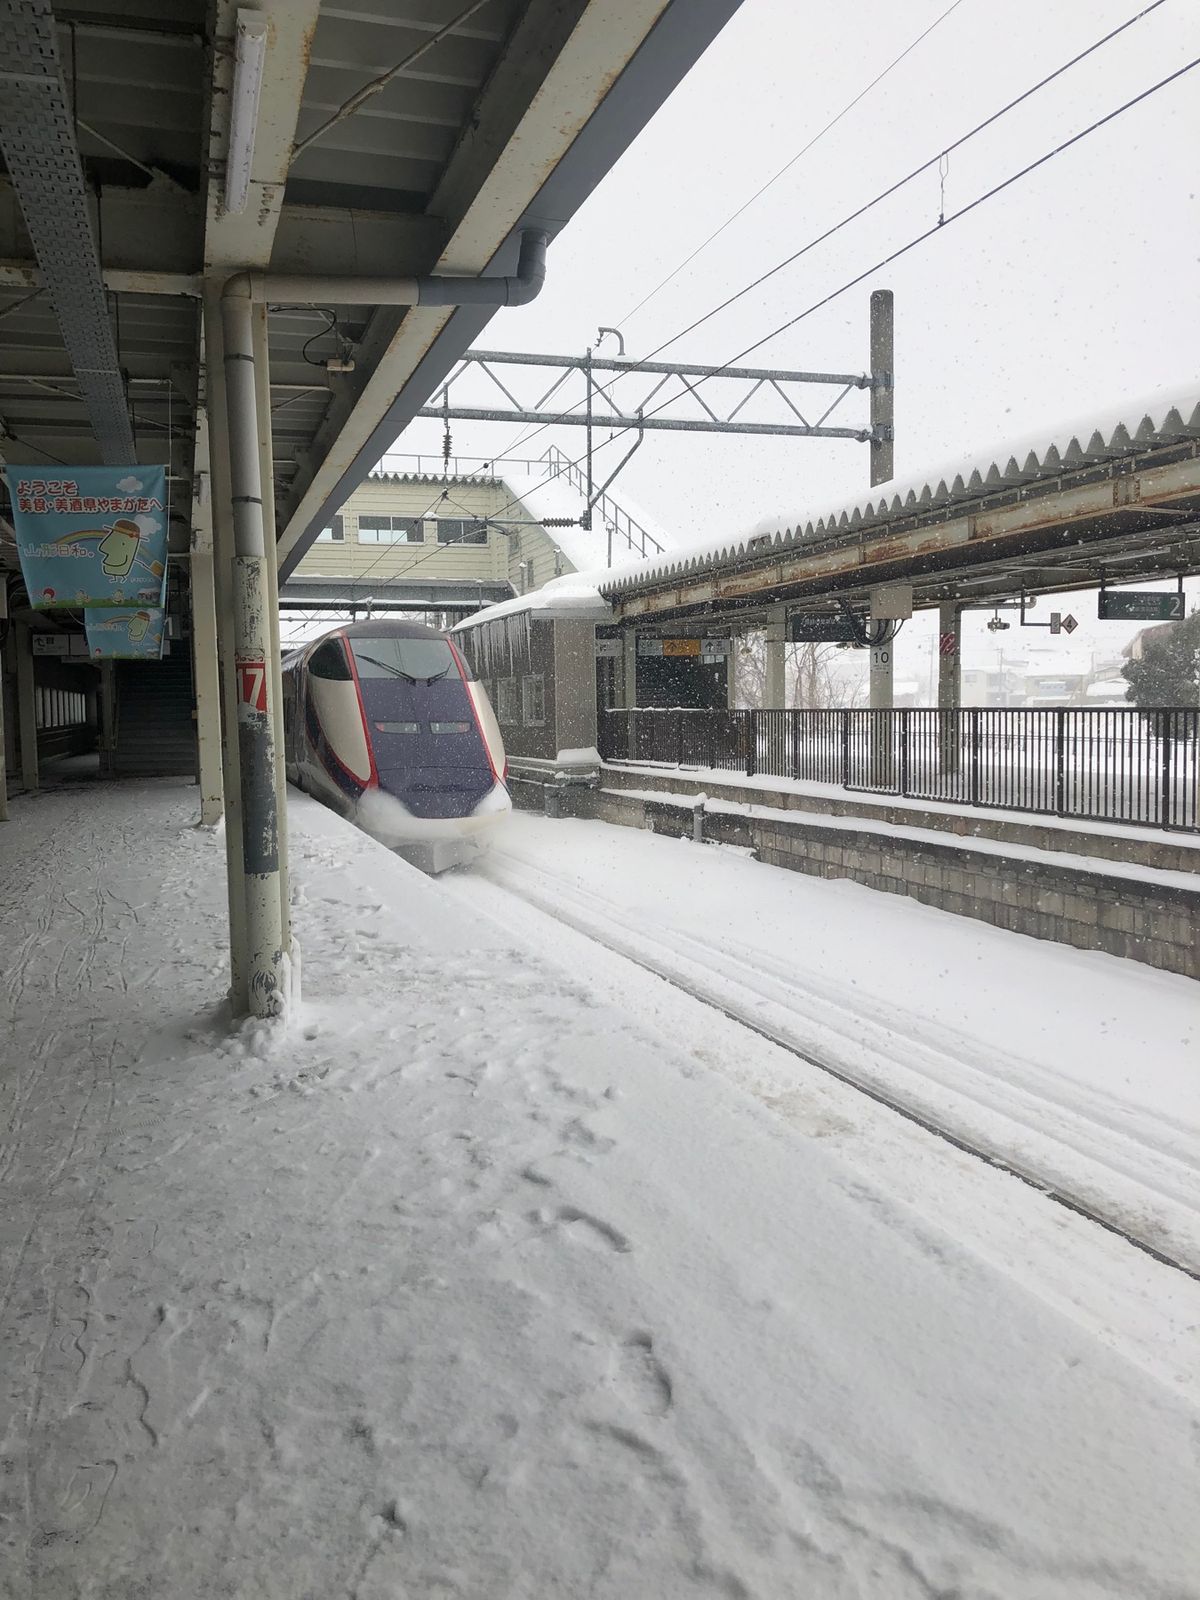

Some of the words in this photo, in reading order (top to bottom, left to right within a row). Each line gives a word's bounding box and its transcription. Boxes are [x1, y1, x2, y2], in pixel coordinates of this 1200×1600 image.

[17, 480, 78, 496] ようこそ
[1169, 596, 1181, 616] 2
[873, 652, 889, 664] 10
